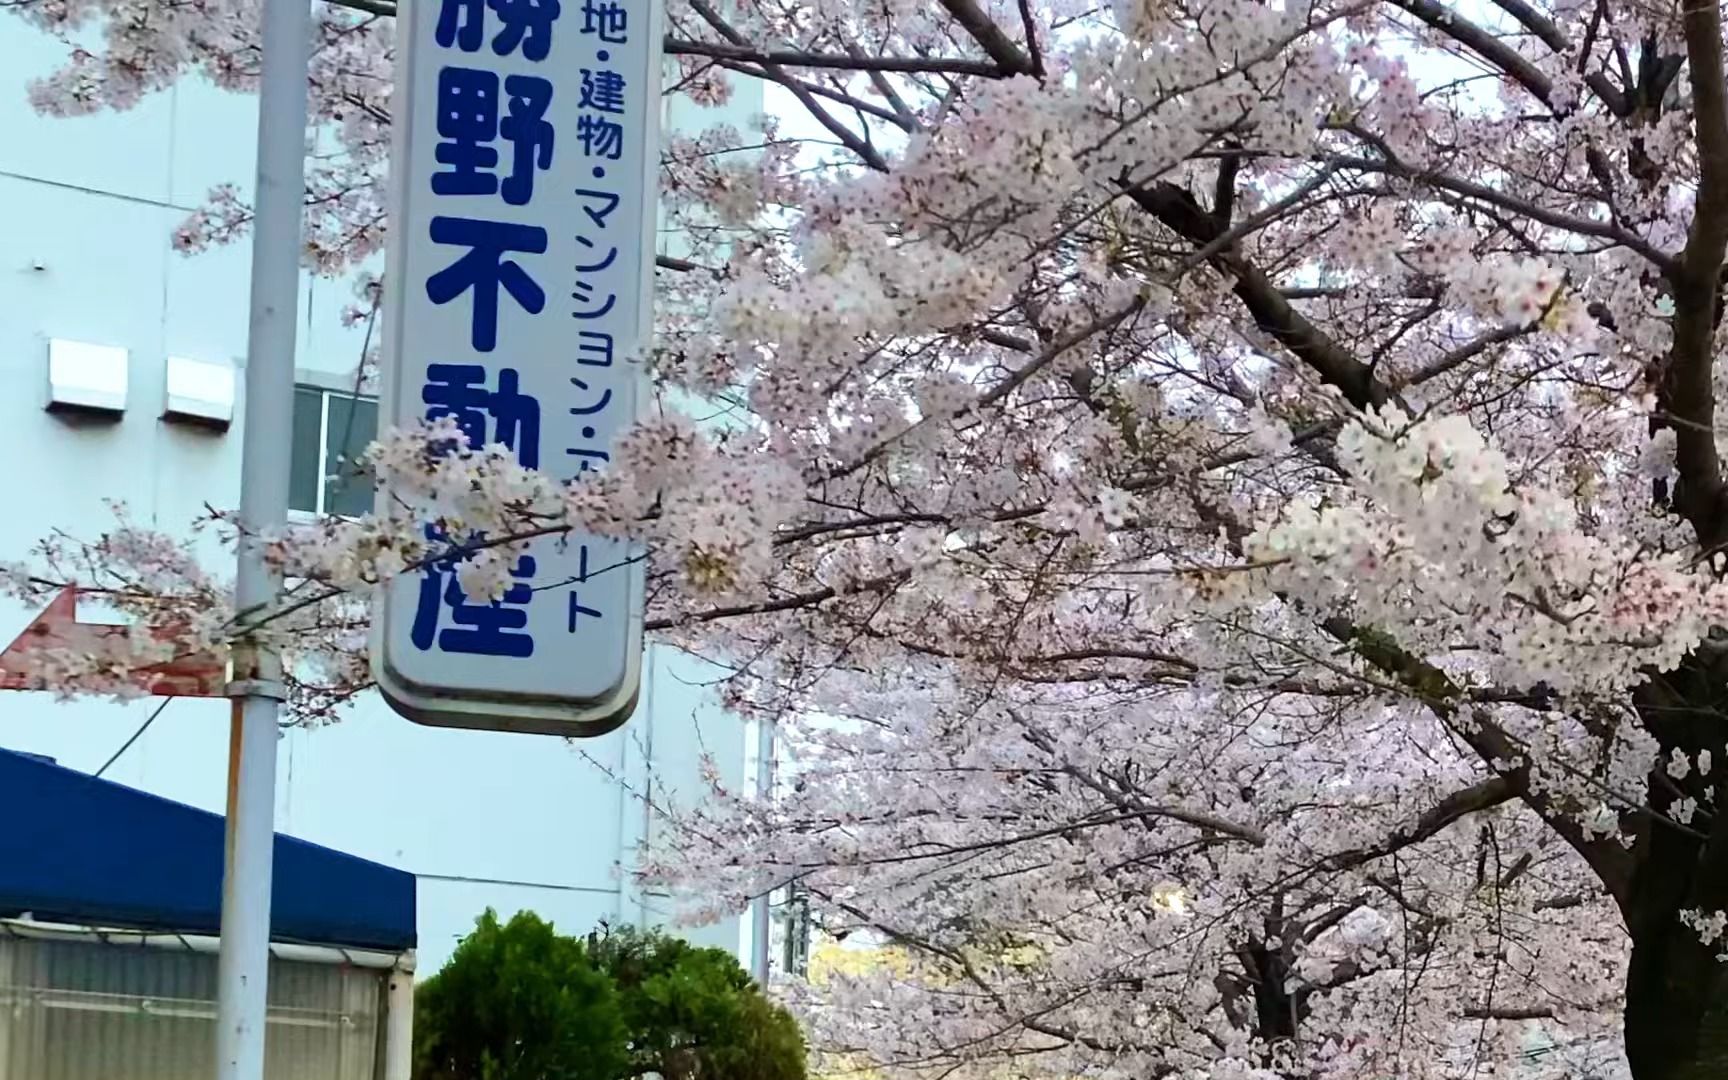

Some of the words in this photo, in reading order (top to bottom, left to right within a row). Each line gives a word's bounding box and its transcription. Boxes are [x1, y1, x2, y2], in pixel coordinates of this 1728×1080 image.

[564, 0, 627, 633] 地・建物・マンション・アート
